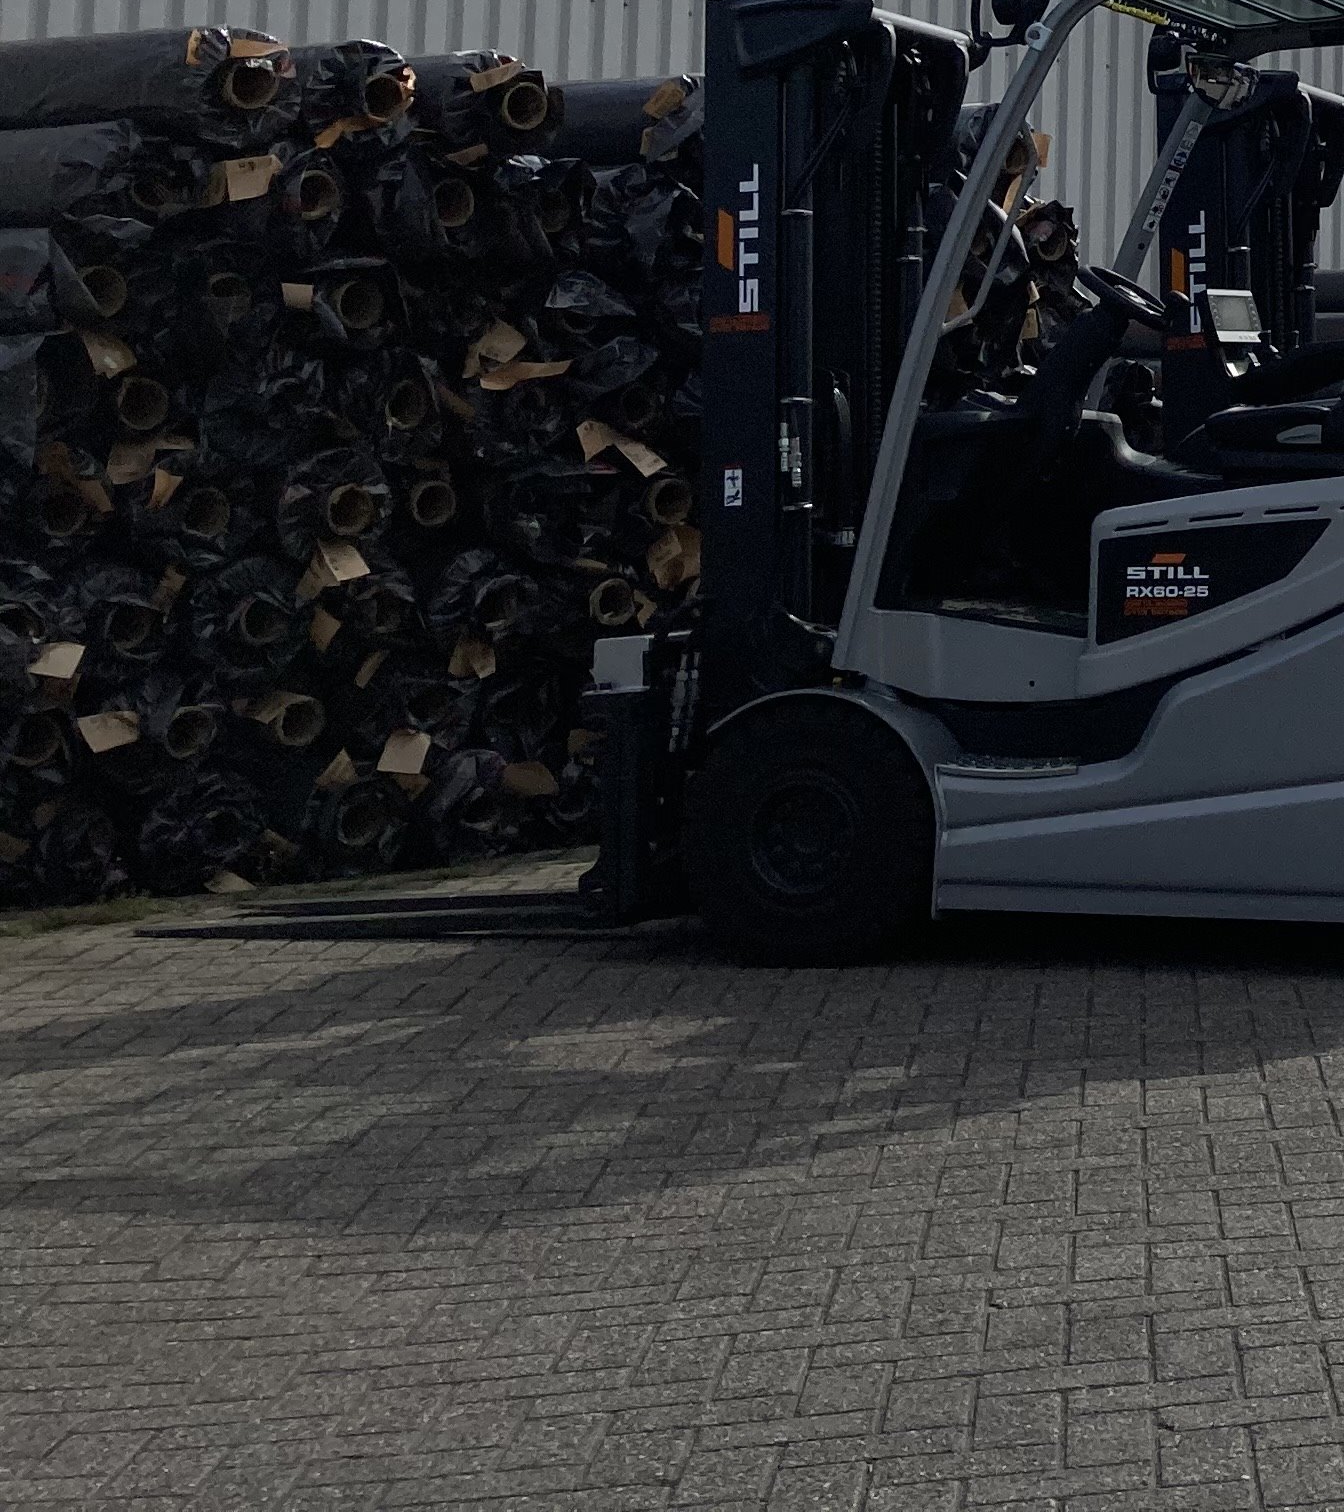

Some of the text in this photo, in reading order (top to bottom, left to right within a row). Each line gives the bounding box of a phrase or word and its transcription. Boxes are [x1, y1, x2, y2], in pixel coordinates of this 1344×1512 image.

[739, 163, 759, 313] STILL
[1188, 210, 1207, 334] STILL
[1126, 566, 1210, 580] STILL
[1126, 585, 1209, 598] RX60-25
